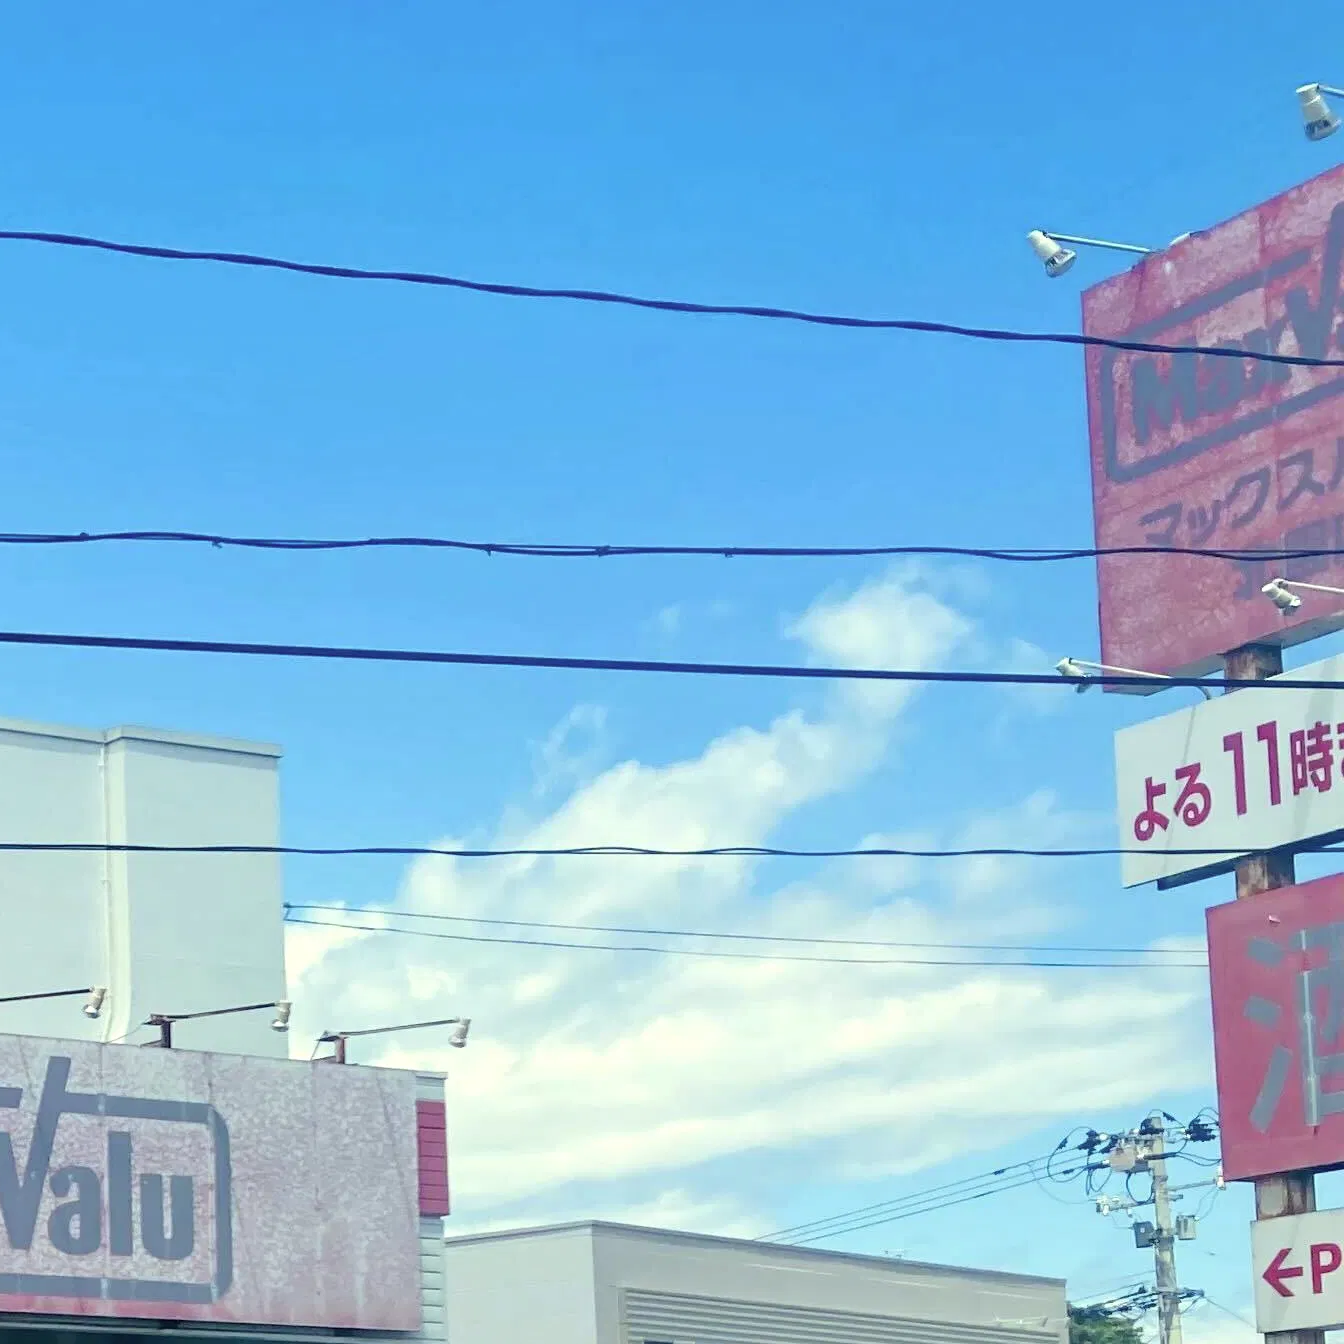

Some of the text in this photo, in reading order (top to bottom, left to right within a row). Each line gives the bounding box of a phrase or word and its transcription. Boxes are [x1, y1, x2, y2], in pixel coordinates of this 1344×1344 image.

[1131, 200, 1344, 446] MaxV
[1134, 720, 1344, 841] よる11時
[1310, 1243, 1342, 1294] P
